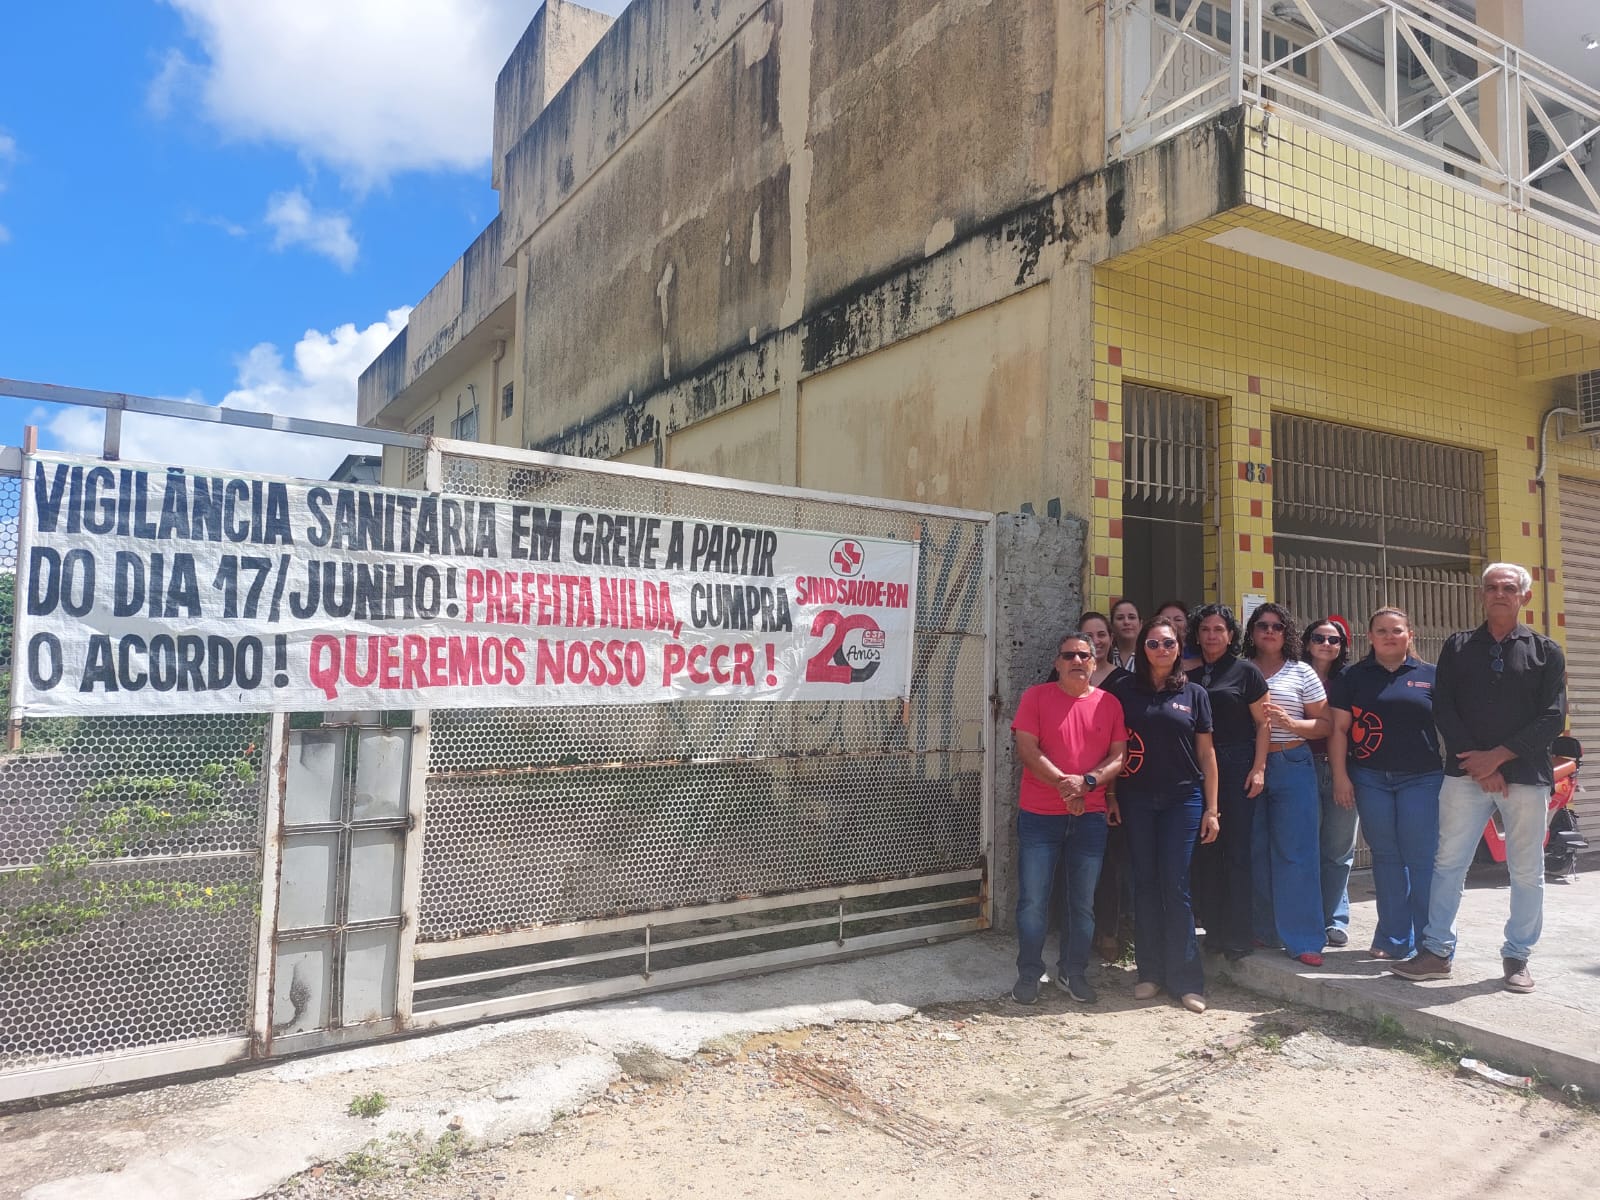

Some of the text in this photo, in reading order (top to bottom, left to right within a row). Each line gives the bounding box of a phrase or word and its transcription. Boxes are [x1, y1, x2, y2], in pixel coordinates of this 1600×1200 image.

[35, 461, 778, 578] VIGILÂNCIA SANITÁRIA EM GREVE A PARTIR
[28, 547, 95, 618] DO
[114, 553, 200, 619] DIA
[465, 569, 596, 626] PREFEITA
[598, 577, 683, 640] NILDA,
[690, 583, 793, 633] CUMPRA
[795, 574, 909, 609] SINDSAÚDE-RN
[28, 633, 63, 692] O
[309, 634, 526, 701] QUEREMOS
[536, 640, 646, 687] NOSSO
[847, 645, 881, 661] Anos
